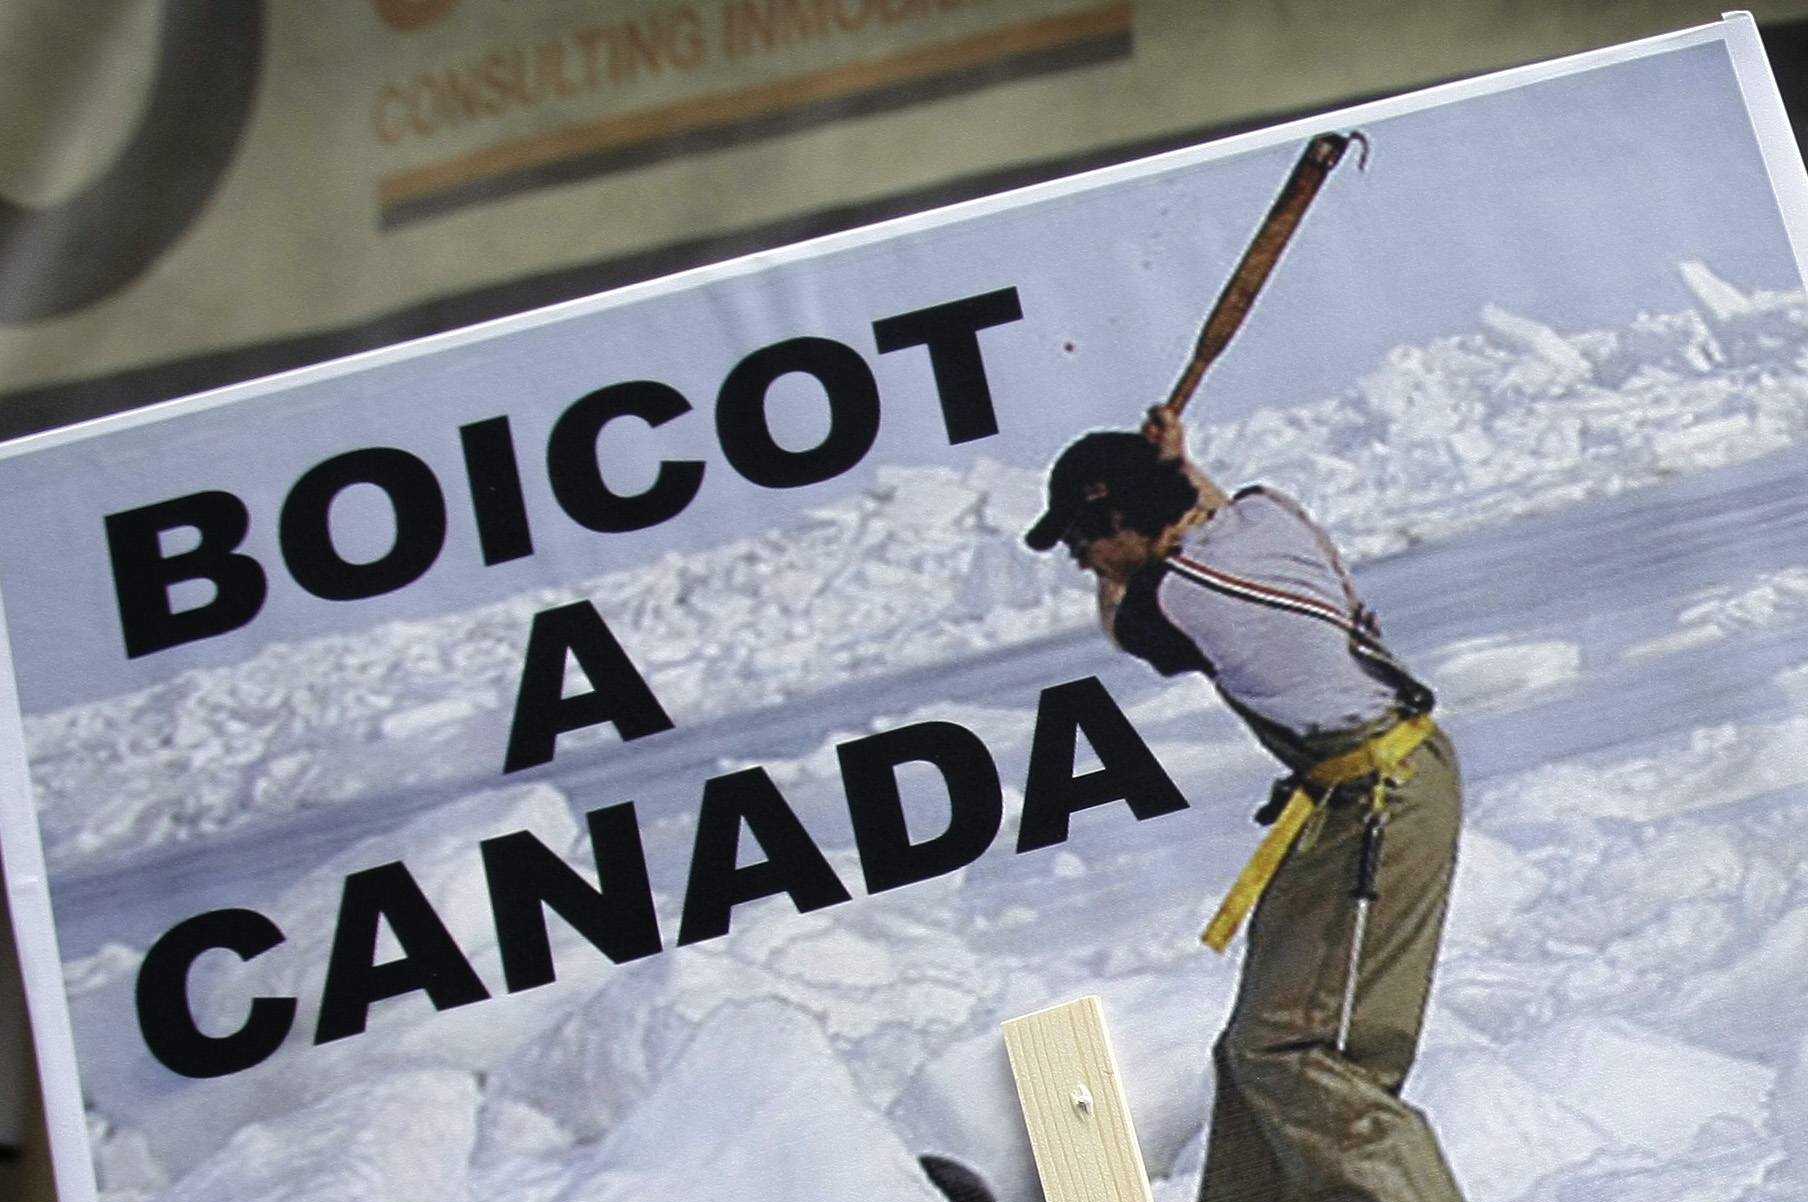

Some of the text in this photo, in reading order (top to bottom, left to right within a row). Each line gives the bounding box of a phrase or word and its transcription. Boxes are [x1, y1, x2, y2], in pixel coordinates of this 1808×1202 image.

[370, 5, 706, 145] CONSULTING
[105, 286, 1022, 660] BOICOT
[504, 599, 676, 775] A
[135, 674, 1191, 1079] CANADA
